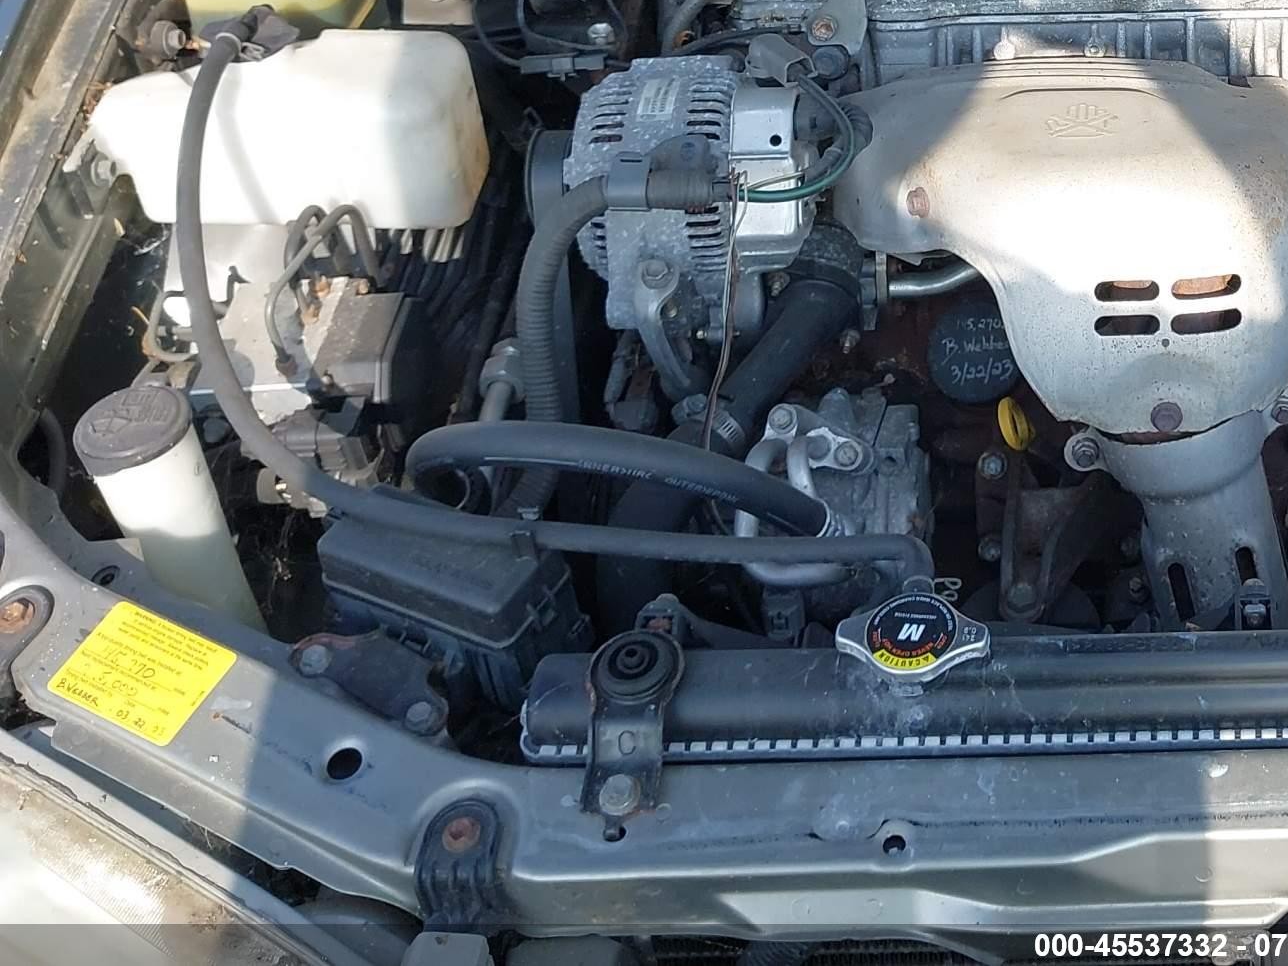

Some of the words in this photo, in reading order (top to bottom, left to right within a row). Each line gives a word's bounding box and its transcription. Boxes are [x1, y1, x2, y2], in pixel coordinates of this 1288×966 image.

[897, 623, 926, 642] M
[878, 651, 921, 668] CAUTION
[617, 730, 637, 755] C
